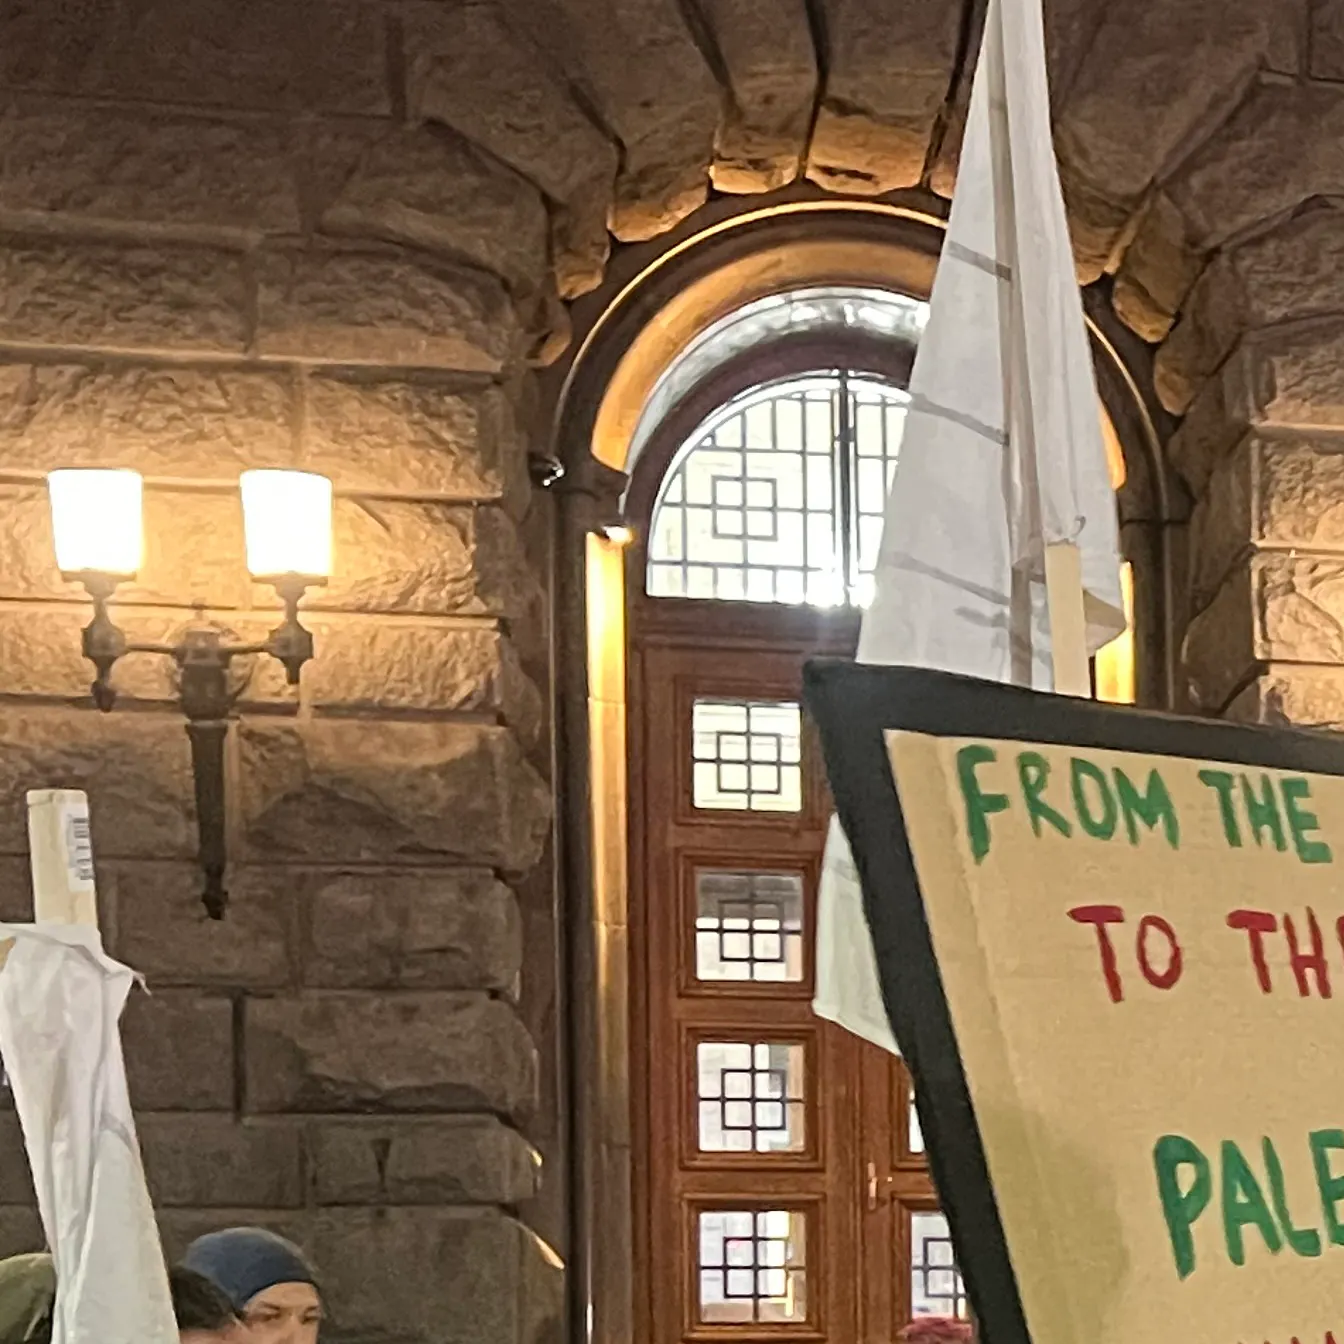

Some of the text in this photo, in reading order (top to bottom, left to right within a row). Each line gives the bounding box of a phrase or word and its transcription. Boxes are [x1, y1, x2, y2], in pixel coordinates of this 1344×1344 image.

[957, 745, 1181, 864] FROM
[1199, 770, 1333, 865] THE
[1067, 904, 1184, 1002] TO
